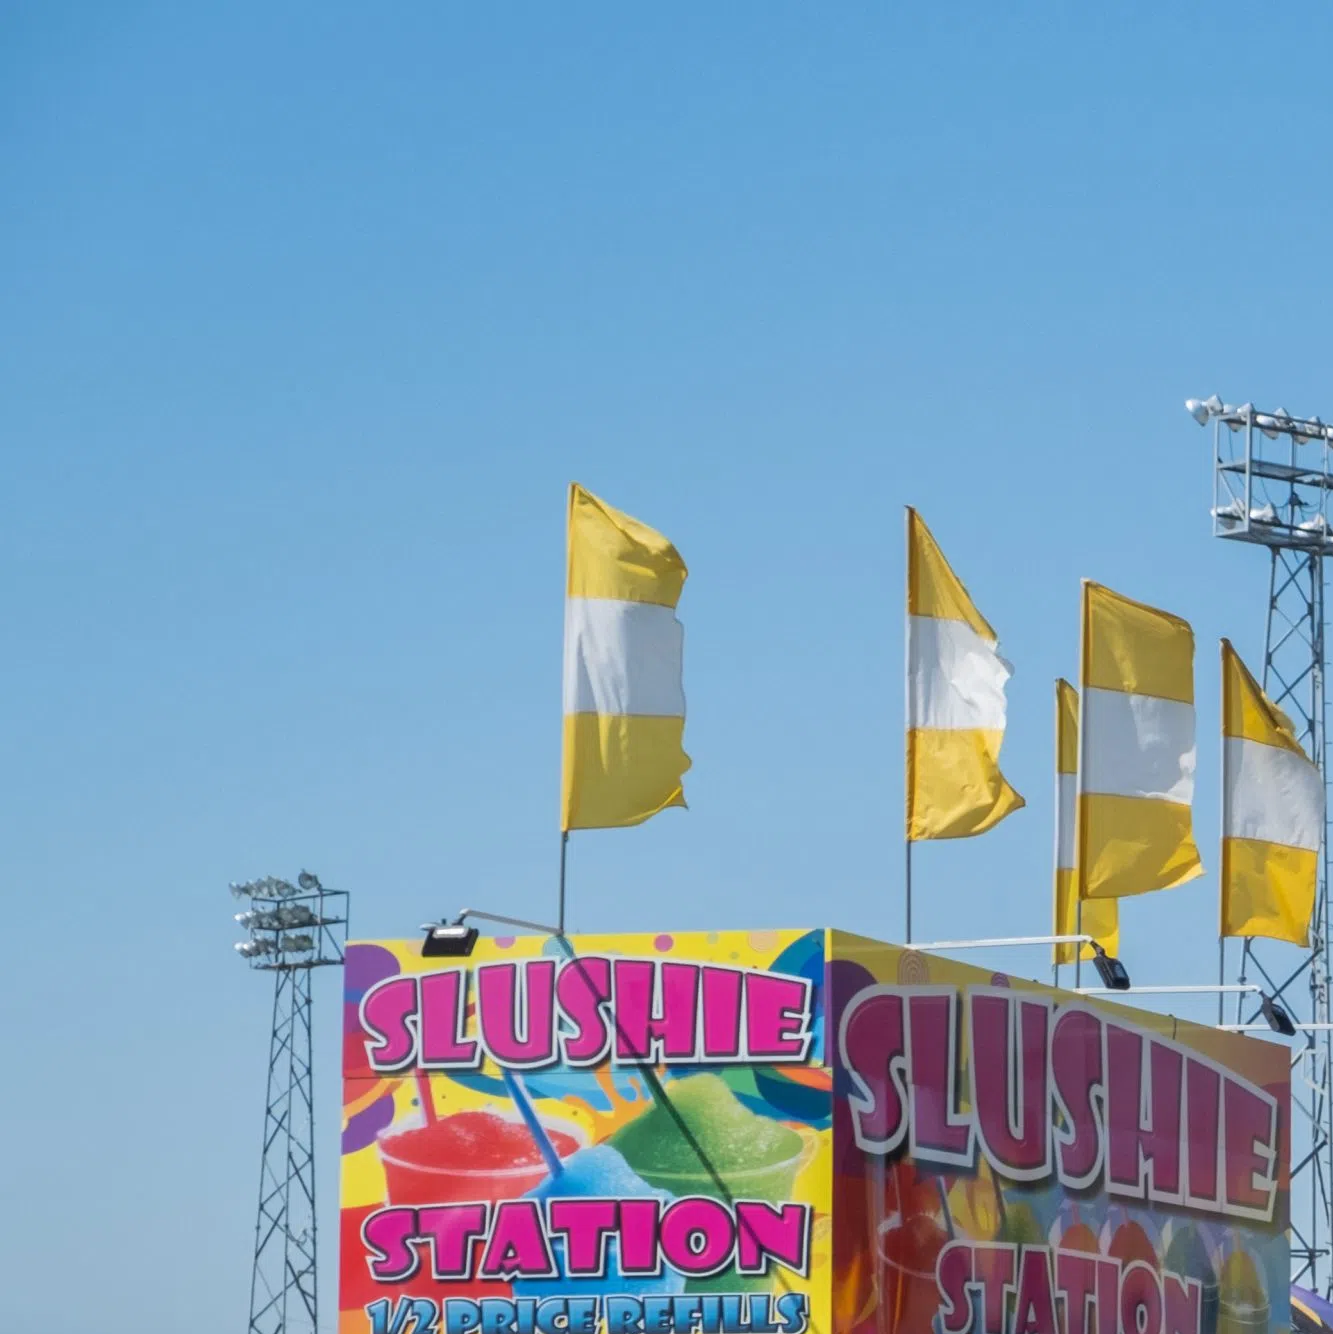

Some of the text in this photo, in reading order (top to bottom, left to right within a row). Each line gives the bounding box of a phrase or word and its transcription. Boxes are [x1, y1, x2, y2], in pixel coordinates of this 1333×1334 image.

[359, 955, 813, 1071] SLUSHIE
[838, 983, 1278, 1223] SLUSHIE
[361, 1195, 812, 1280] STATION
